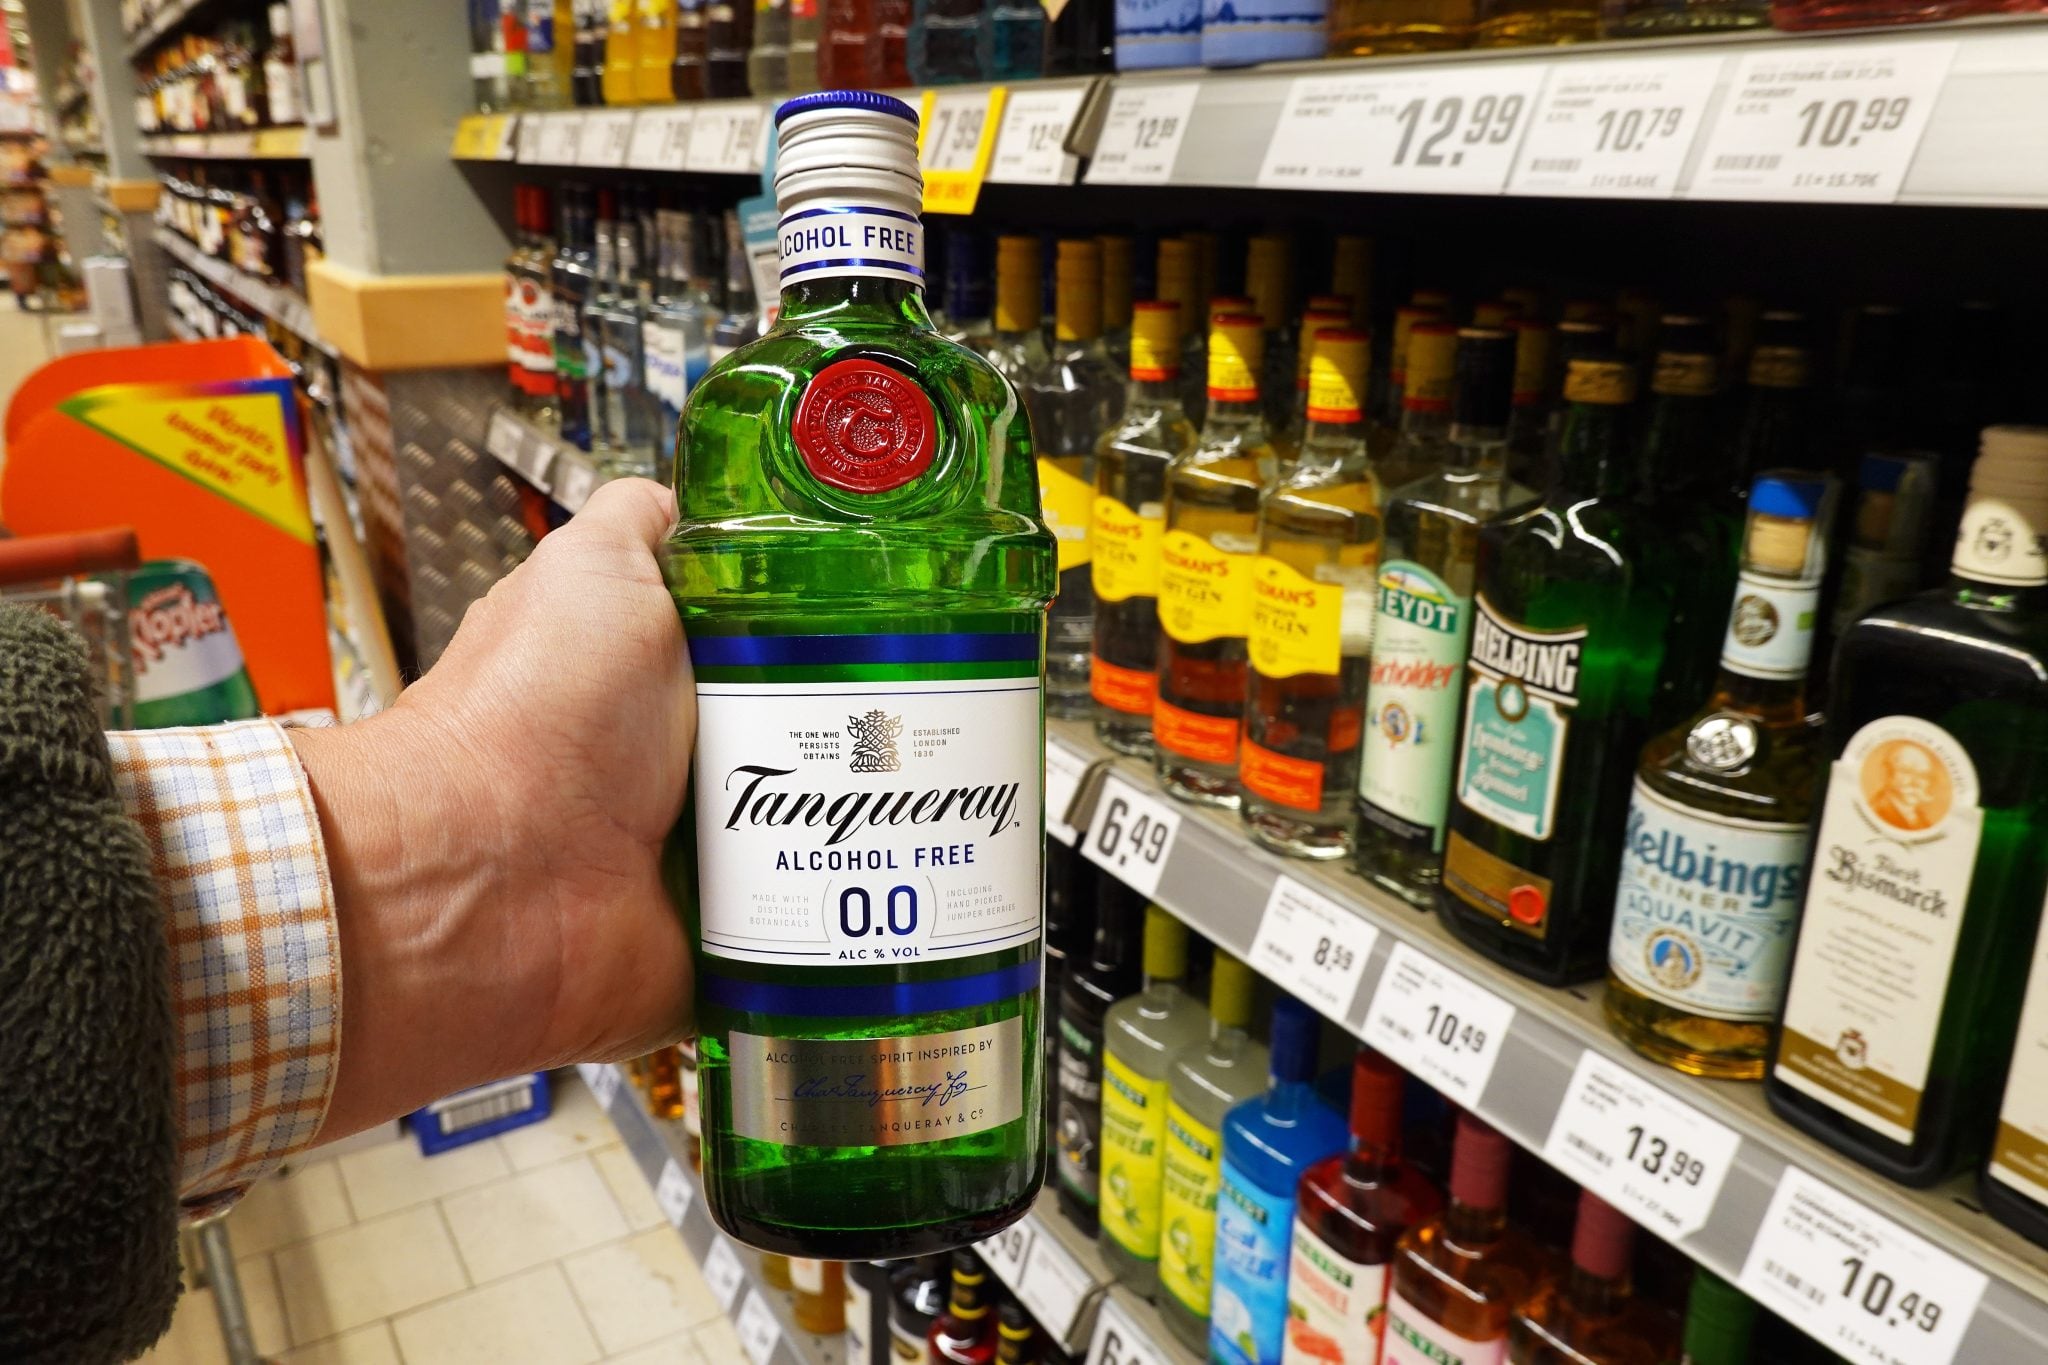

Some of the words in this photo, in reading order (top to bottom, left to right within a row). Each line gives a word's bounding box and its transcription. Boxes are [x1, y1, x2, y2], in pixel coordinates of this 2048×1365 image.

[1392, 94, 1524, 166] 12.99
[1596, 107, 1683, 151] 10.79
[1796, 98, 1910, 147] 10.99
[778, 226, 851, 261] LCOHOL
[864, 226, 915, 255] FREE
[1472, 611, 1579, 693] HELBING
[913, 727, 960, 736] ESTABLISHED
[913, 739, 947, 747] LONDON
[725, 765, 1019, 846] Tanqueray
[1097, 798, 1168, 866] 6.49
[776, 850, 898, 871] ALCOHOL
[915, 844, 975, 868] FREE
[947, 885, 993, 898] INCLUDING
[1826, 844, 1947, 918] Bismarck
[752, 894, 777, 902] MADE
[757, 905, 809, 916] DISTILLED
[839, 885, 918, 938] 0.0
[947, 899, 970, 910] HAND
[974, 895, 1003, 907] PICKED
[947, 909, 983, 921] JUNIPER
[986, 904, 1016, 916] BERRIES
[750, 918, 809, 927] BOTANICALS
[839, 949, 866, 960] ALC
[874, 948, 885, 959] %
[892, 947, 920, 958] VOL
[1427, 1004, 1486, 1053] 10.49
[766, 1053, 824, 1064] ALCOHOL
[832, 1055, 864, 1065] FREE
[871, 1052, 913, 1064] SPIRIT
[918, 1044, 975, 1061] INSPIRED
[979, 1039, 993, 1053] BY
[859, 1116, 952, 1133] TANQUERAY
[958, 1113, 965, 1123] &
[1626, 1125, 1705, 1186] 13.99
[1840, 1257, 1942, 1334] 10.49
